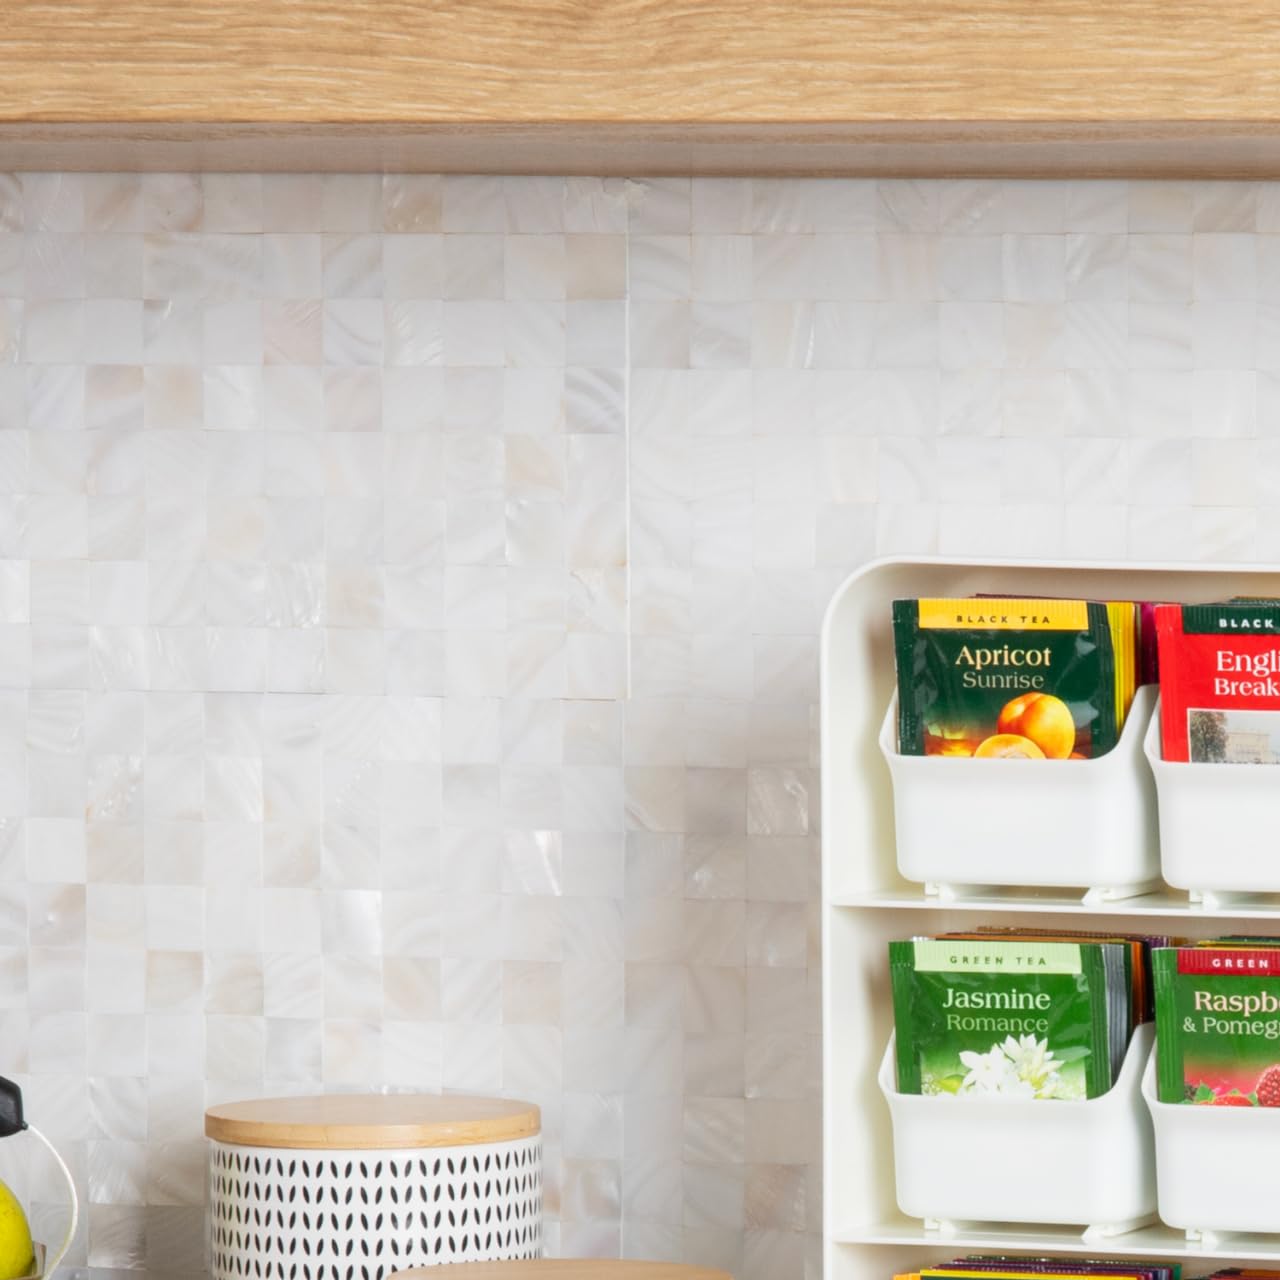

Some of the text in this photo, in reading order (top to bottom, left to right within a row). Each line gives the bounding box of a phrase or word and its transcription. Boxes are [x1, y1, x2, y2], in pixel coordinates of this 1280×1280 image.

[956, 615, 1051, 624] BLACK TEA
[1218, 618, 1275, 629] BLACK
[955, 645, 1052, 669] Apricot
[962, 671, 1044, 690] Sunrise
[949, 955, 1048, 966] GREEN TEA
[1211, 958, 1269, 969] GREEN
[942, 988, 1051, 1010] Jasmine
[946, 1014, 1049, 1033] Romance
[1183, 1017, 1197, 1033] &
